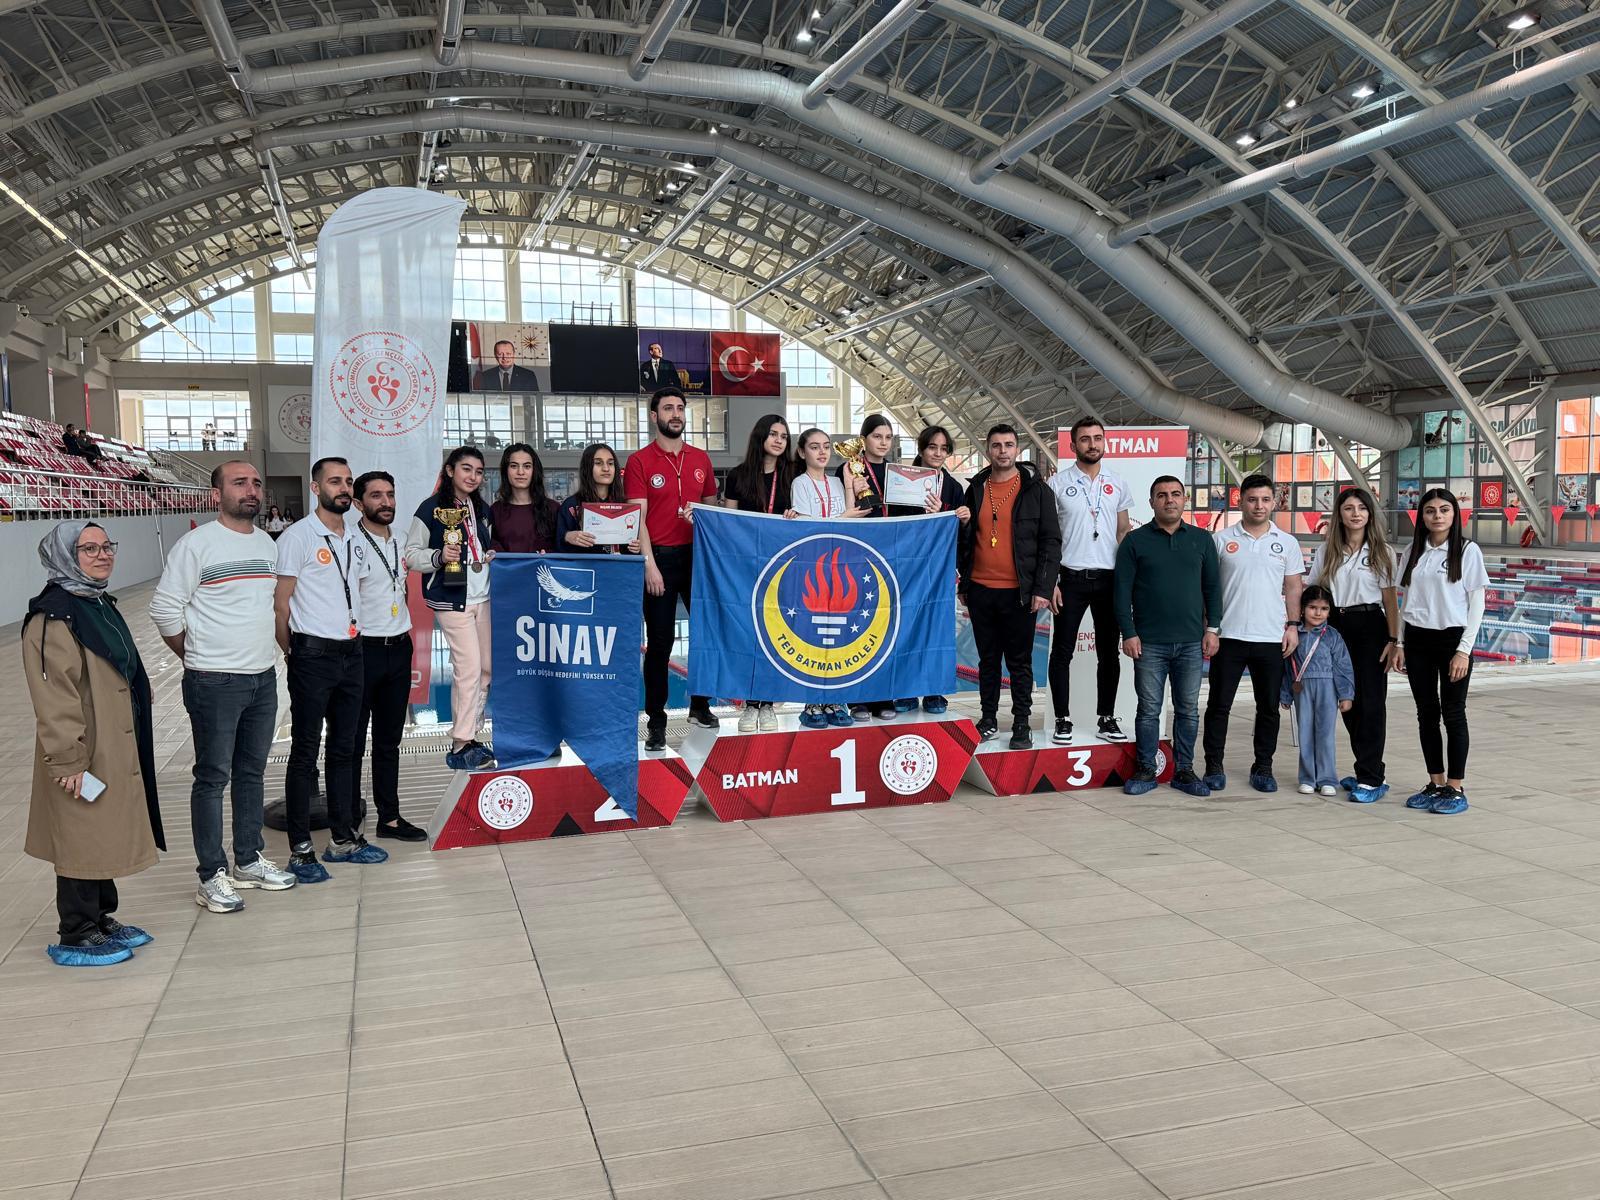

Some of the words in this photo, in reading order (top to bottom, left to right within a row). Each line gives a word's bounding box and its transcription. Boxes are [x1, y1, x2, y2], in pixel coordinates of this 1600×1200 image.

[1104, 437, 1159, 454] TMAN
[516, 615, 617, 666] SINAV
[777, 634, 795, 655] TED
[795, 653, 842, 671] BATMAN
[845, 633, 877, 667] KOLEJİ
[722, 768, 798, 790] BATMAN
[830, 739, 865, 805] 1
[1066, 750, 1092, 786] 3
